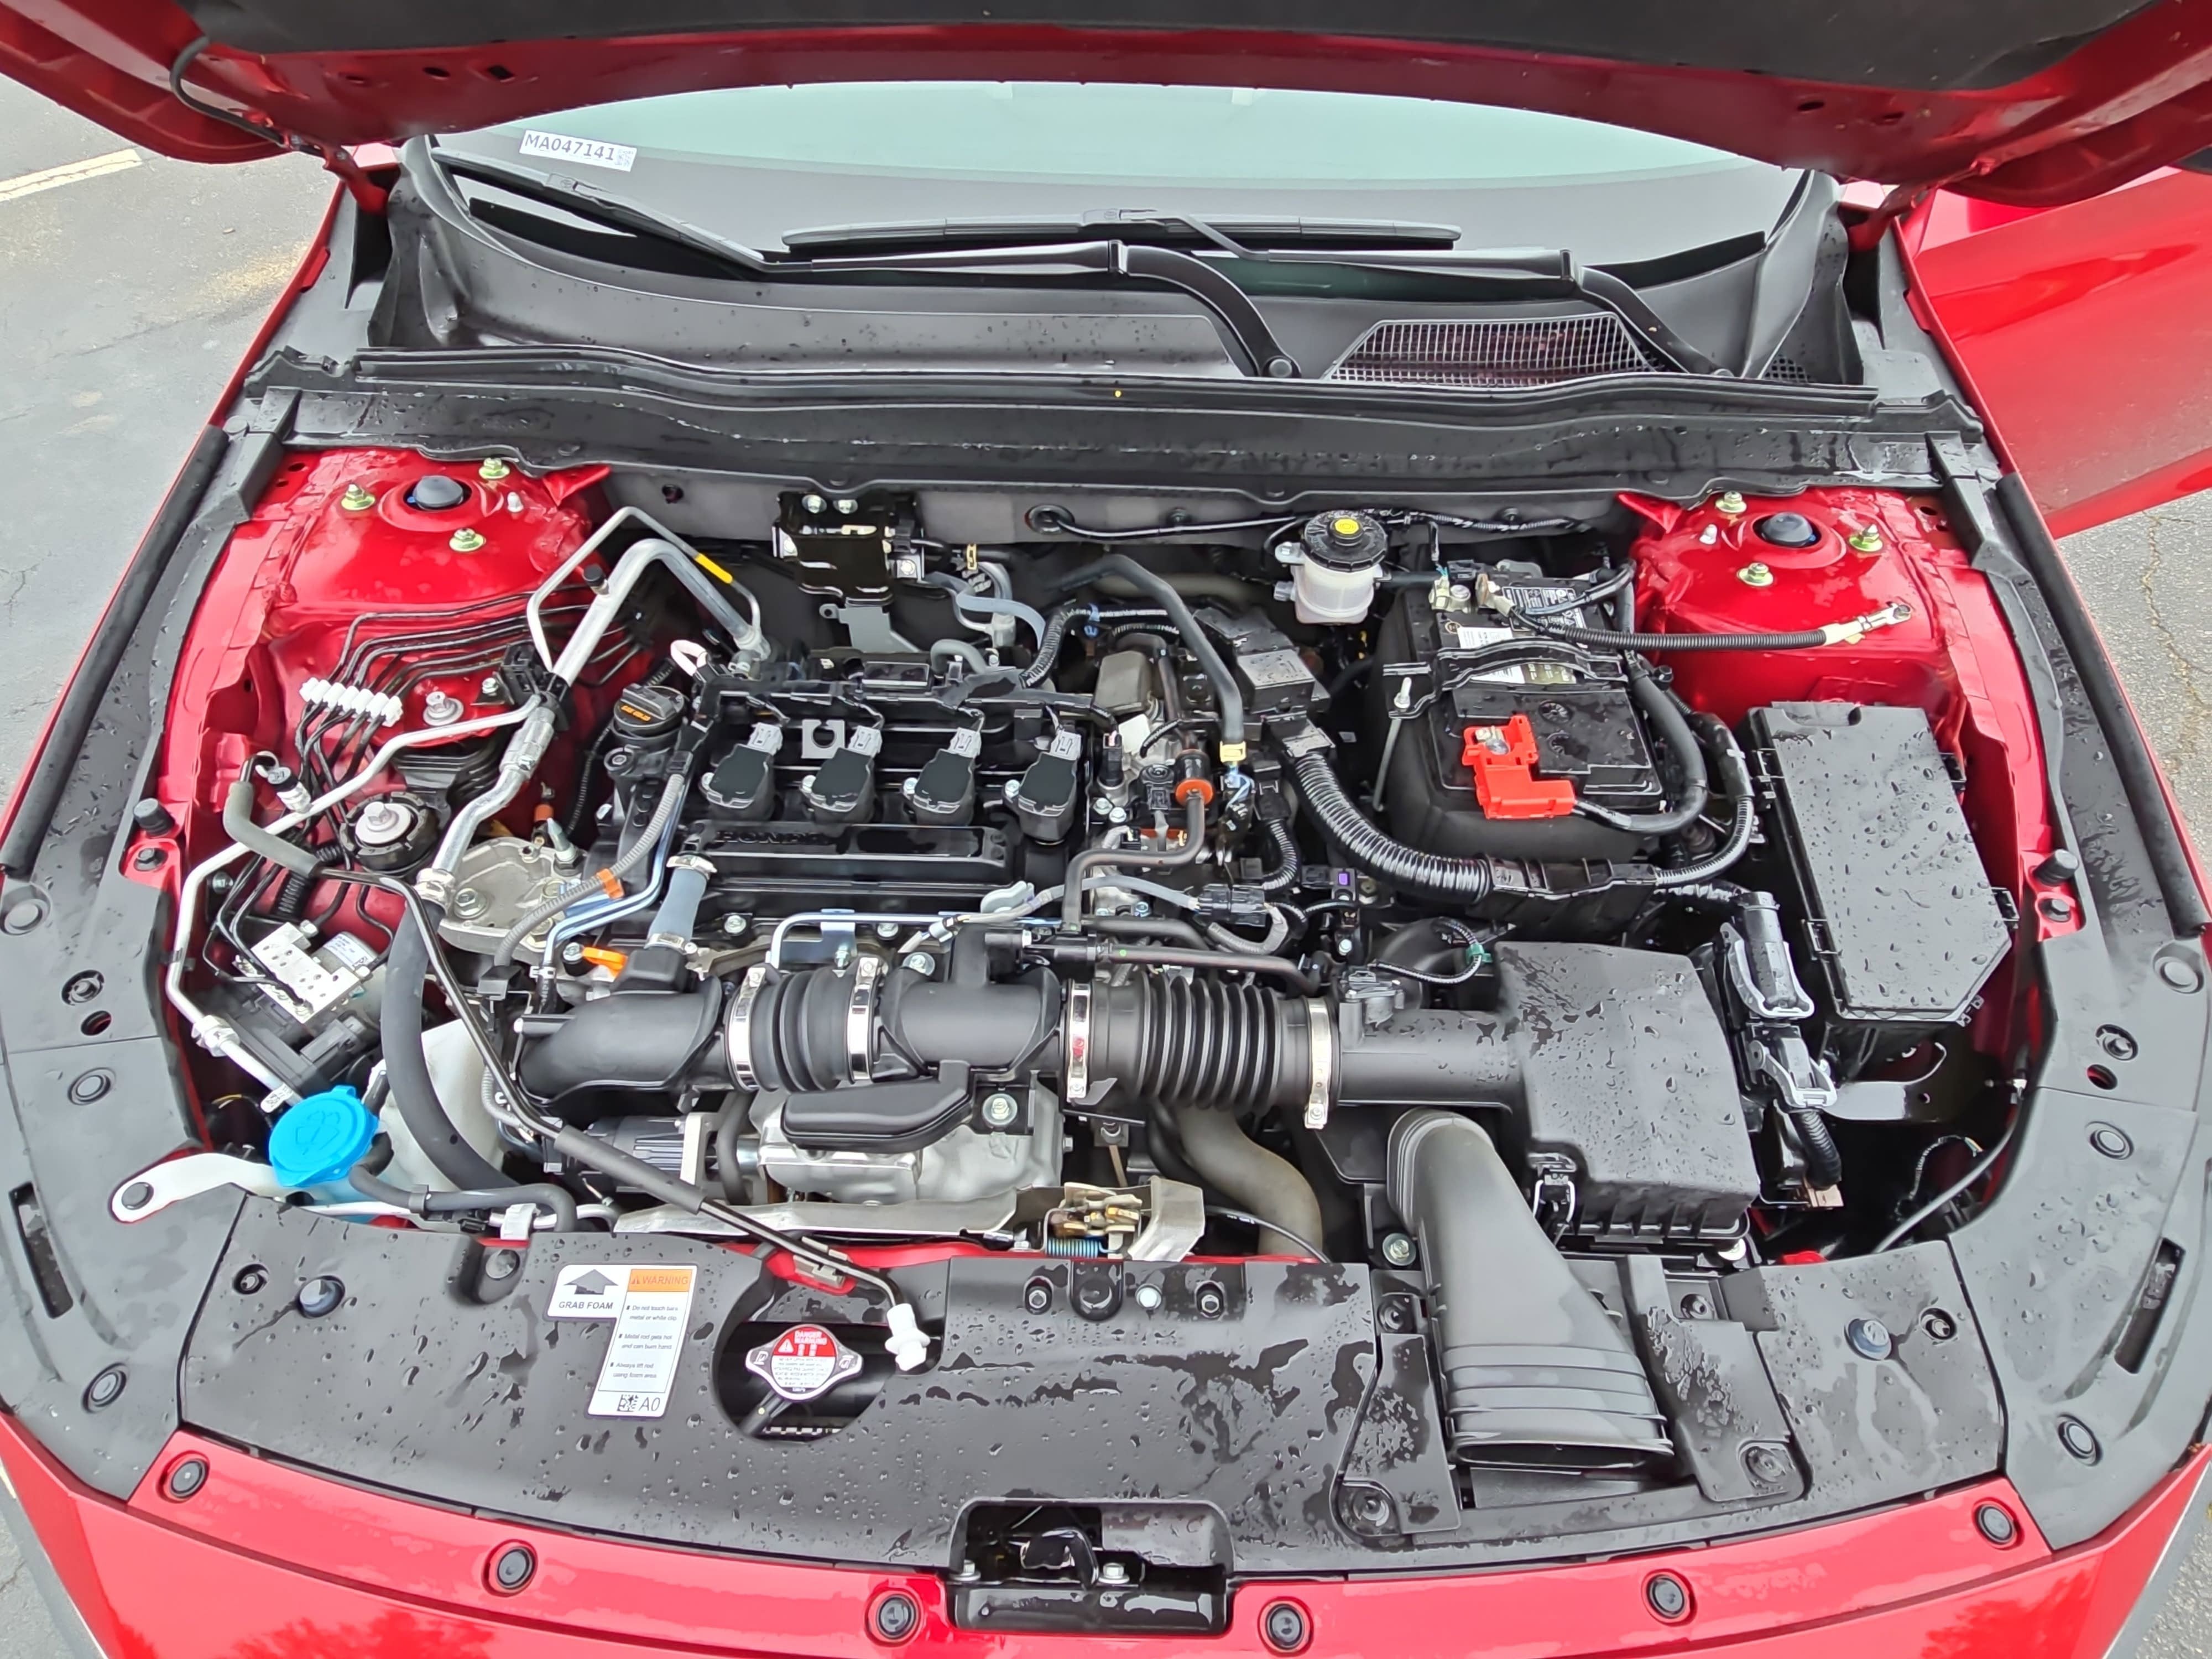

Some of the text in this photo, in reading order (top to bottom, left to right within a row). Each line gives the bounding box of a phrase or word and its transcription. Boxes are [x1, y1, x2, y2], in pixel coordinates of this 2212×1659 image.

[525, 134, 614, 160] MA047141
[643, 1276, 688, 1285] WARNING
[639, 1397, 660, 1412] A0
